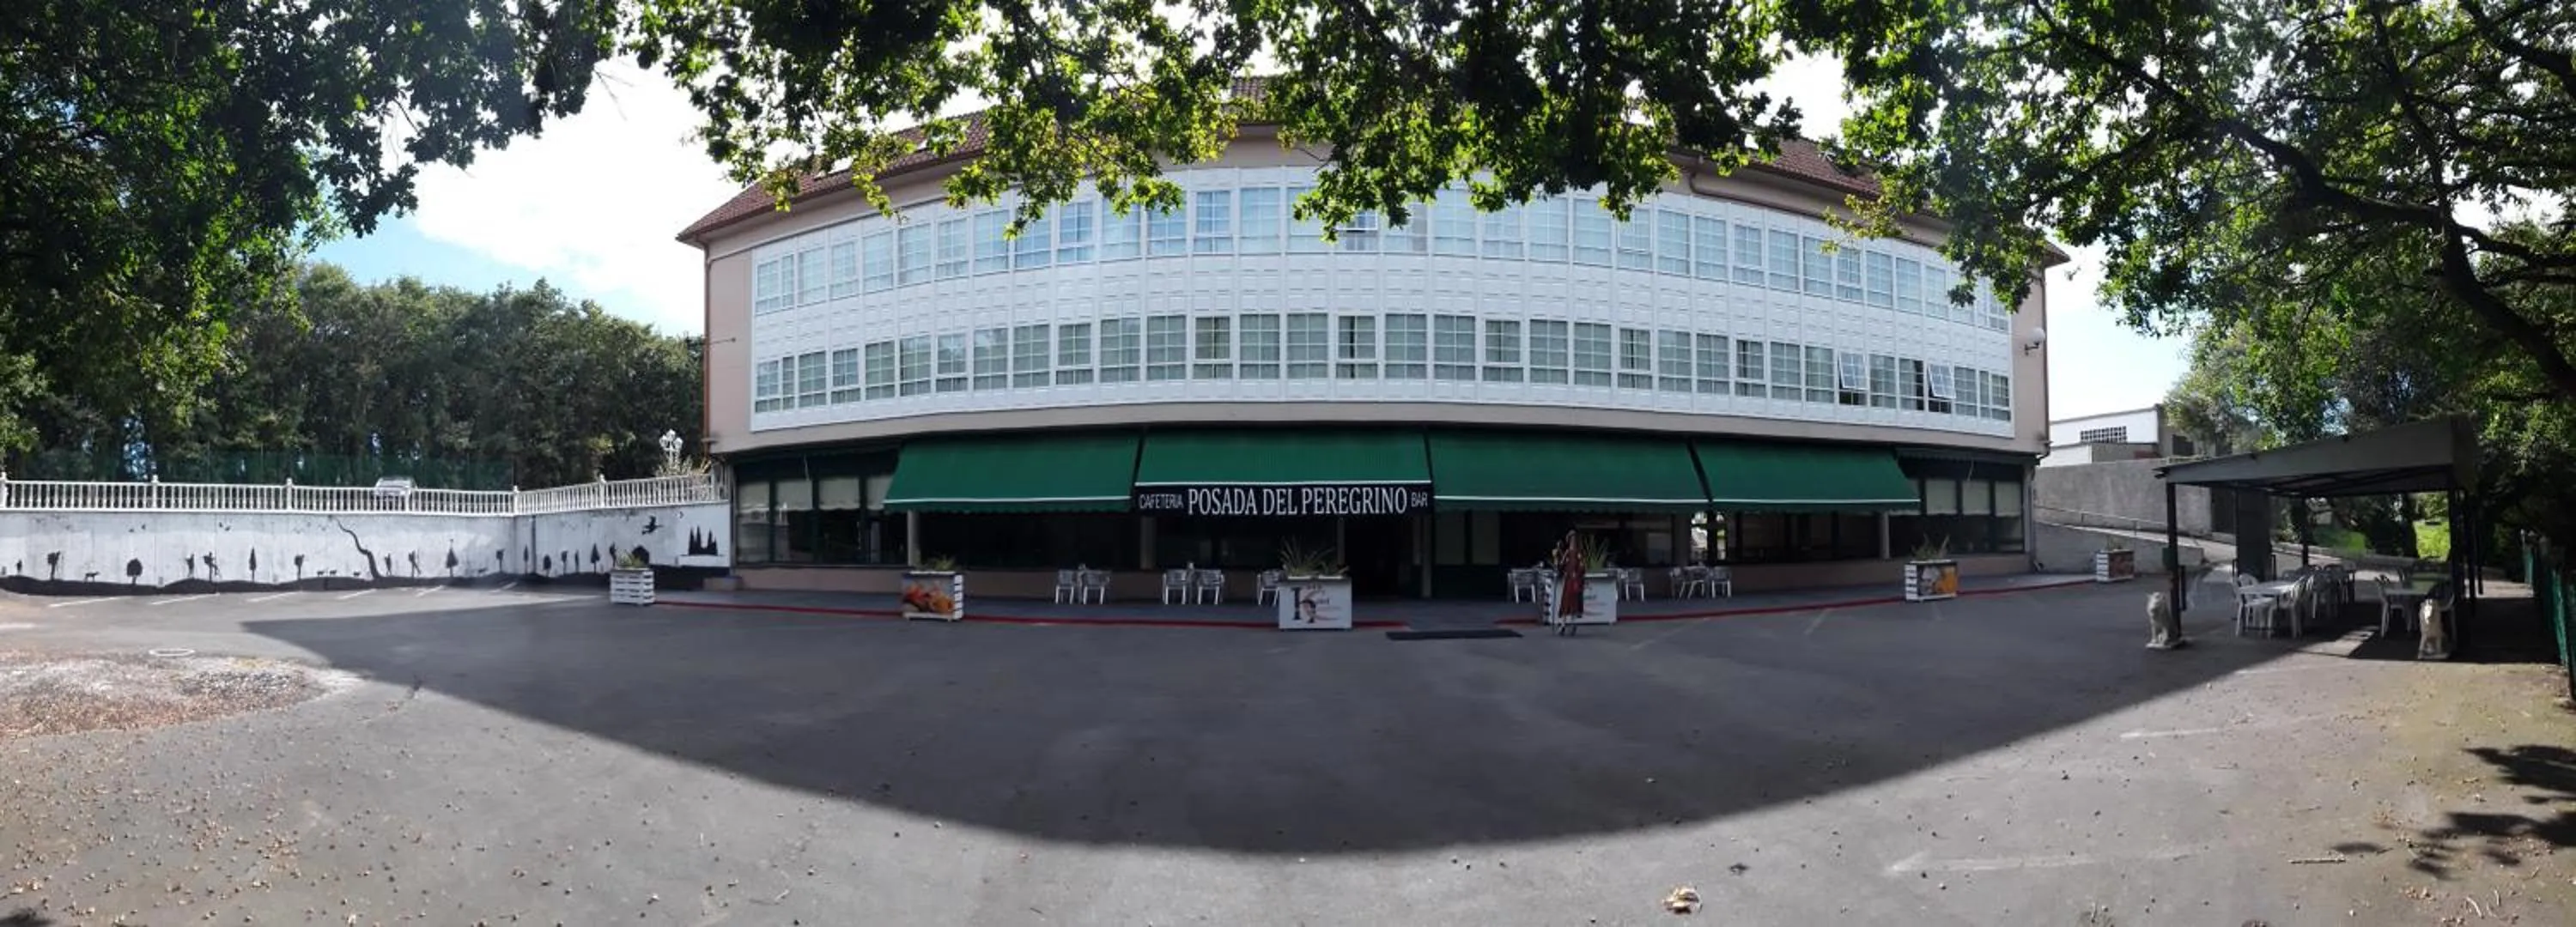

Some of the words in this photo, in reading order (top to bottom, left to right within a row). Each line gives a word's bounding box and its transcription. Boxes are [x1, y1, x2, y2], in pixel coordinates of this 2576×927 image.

[1139, 494, 1184, 509] CAFETERIA
[1188, 488, 1257, 515] POSADA
[1263, 488, 1297, 515] DEL
[1302, 487, 1407, 514] PEREGRINO
[1411, 492, 1428, 507] BAR
